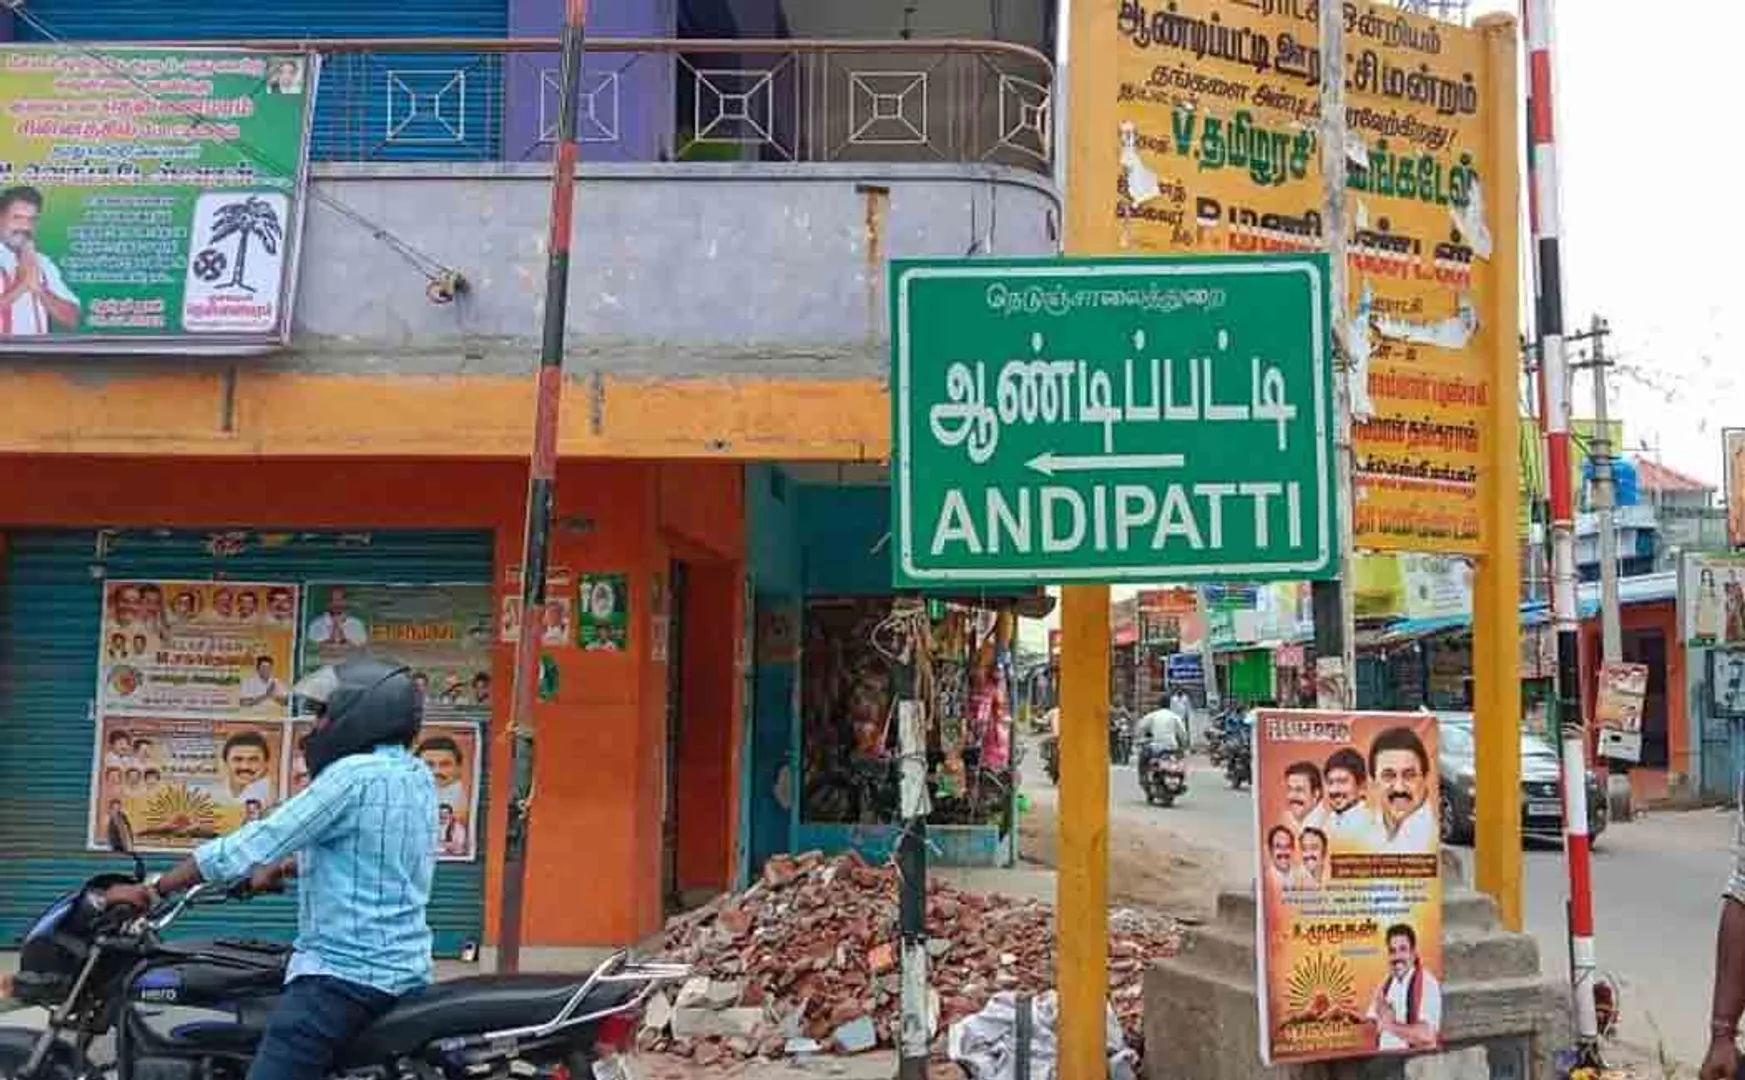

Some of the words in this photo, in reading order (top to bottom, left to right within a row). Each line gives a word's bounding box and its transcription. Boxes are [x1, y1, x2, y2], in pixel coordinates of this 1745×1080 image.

[986, 283, 1226, 316] நெடுஞ்சாலைத்துறை
[930, 329, 1297, 464] ஆண்டிப்பட்டி
[930, 480, 1301, 555] ANDIPATTI
